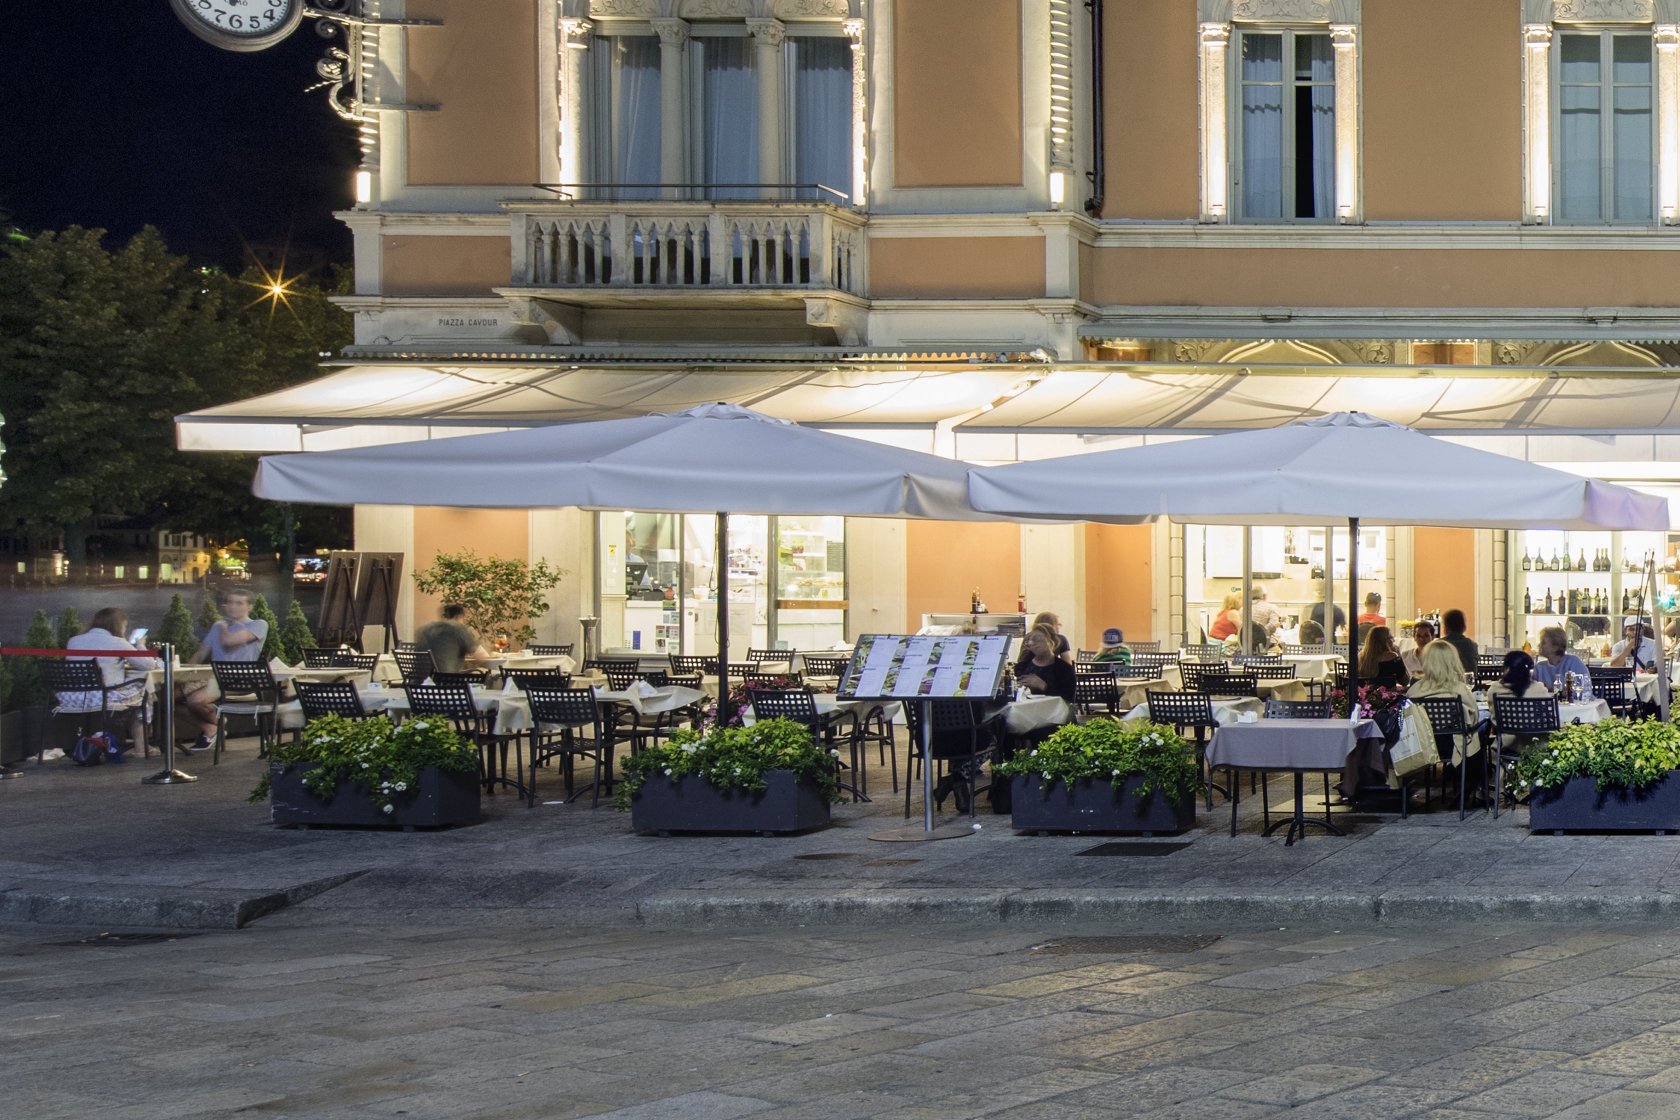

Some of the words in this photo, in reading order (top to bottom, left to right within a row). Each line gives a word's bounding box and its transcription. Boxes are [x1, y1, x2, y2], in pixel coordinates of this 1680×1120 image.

[214, 8, 227, 23] 7
[229, 14, 243, 29] 6
[249, 15, 261, 29] 5
[263, 9, 276, 22] 4
[438, 318, 464, 327] PIAZZA
[468, 318, 498, 327] CAVOUR
